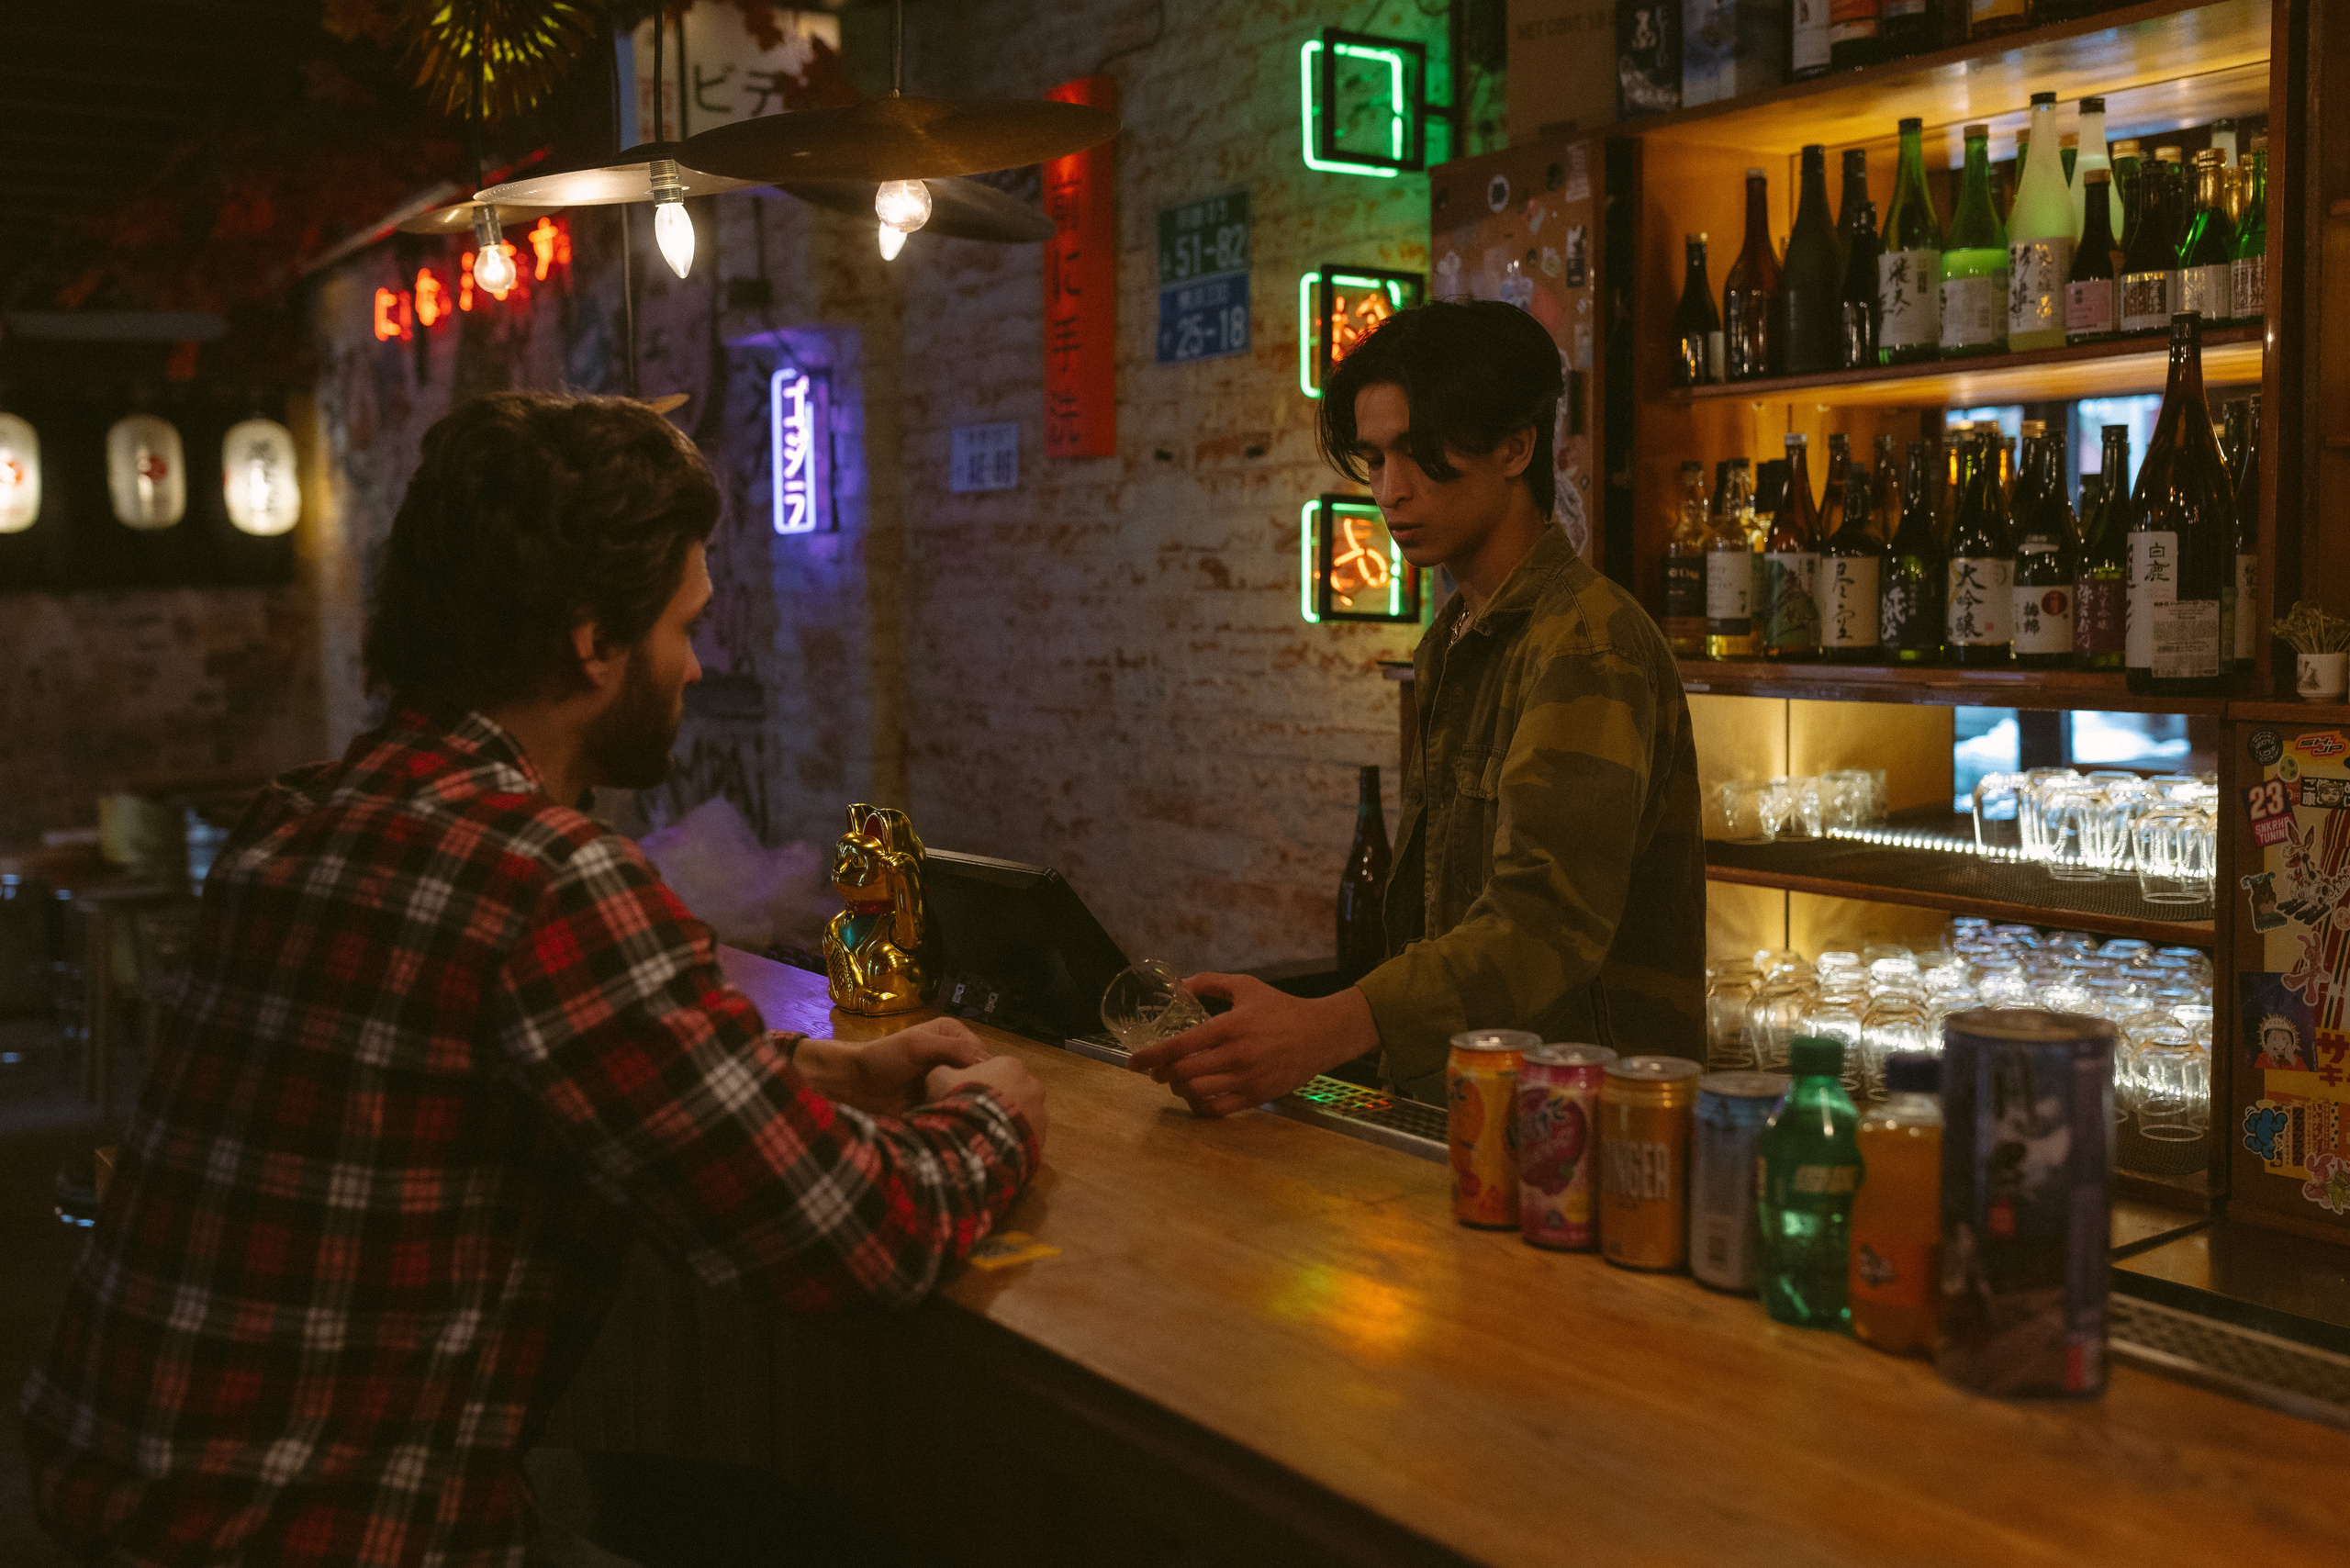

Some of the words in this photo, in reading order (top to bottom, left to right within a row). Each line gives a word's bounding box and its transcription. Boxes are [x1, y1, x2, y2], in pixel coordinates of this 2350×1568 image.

[2144, 543, 2170, 582] 白鹿
[2249, 780, 2285, 821] 23
[2258, 828, 2286, 844] TUNIN
